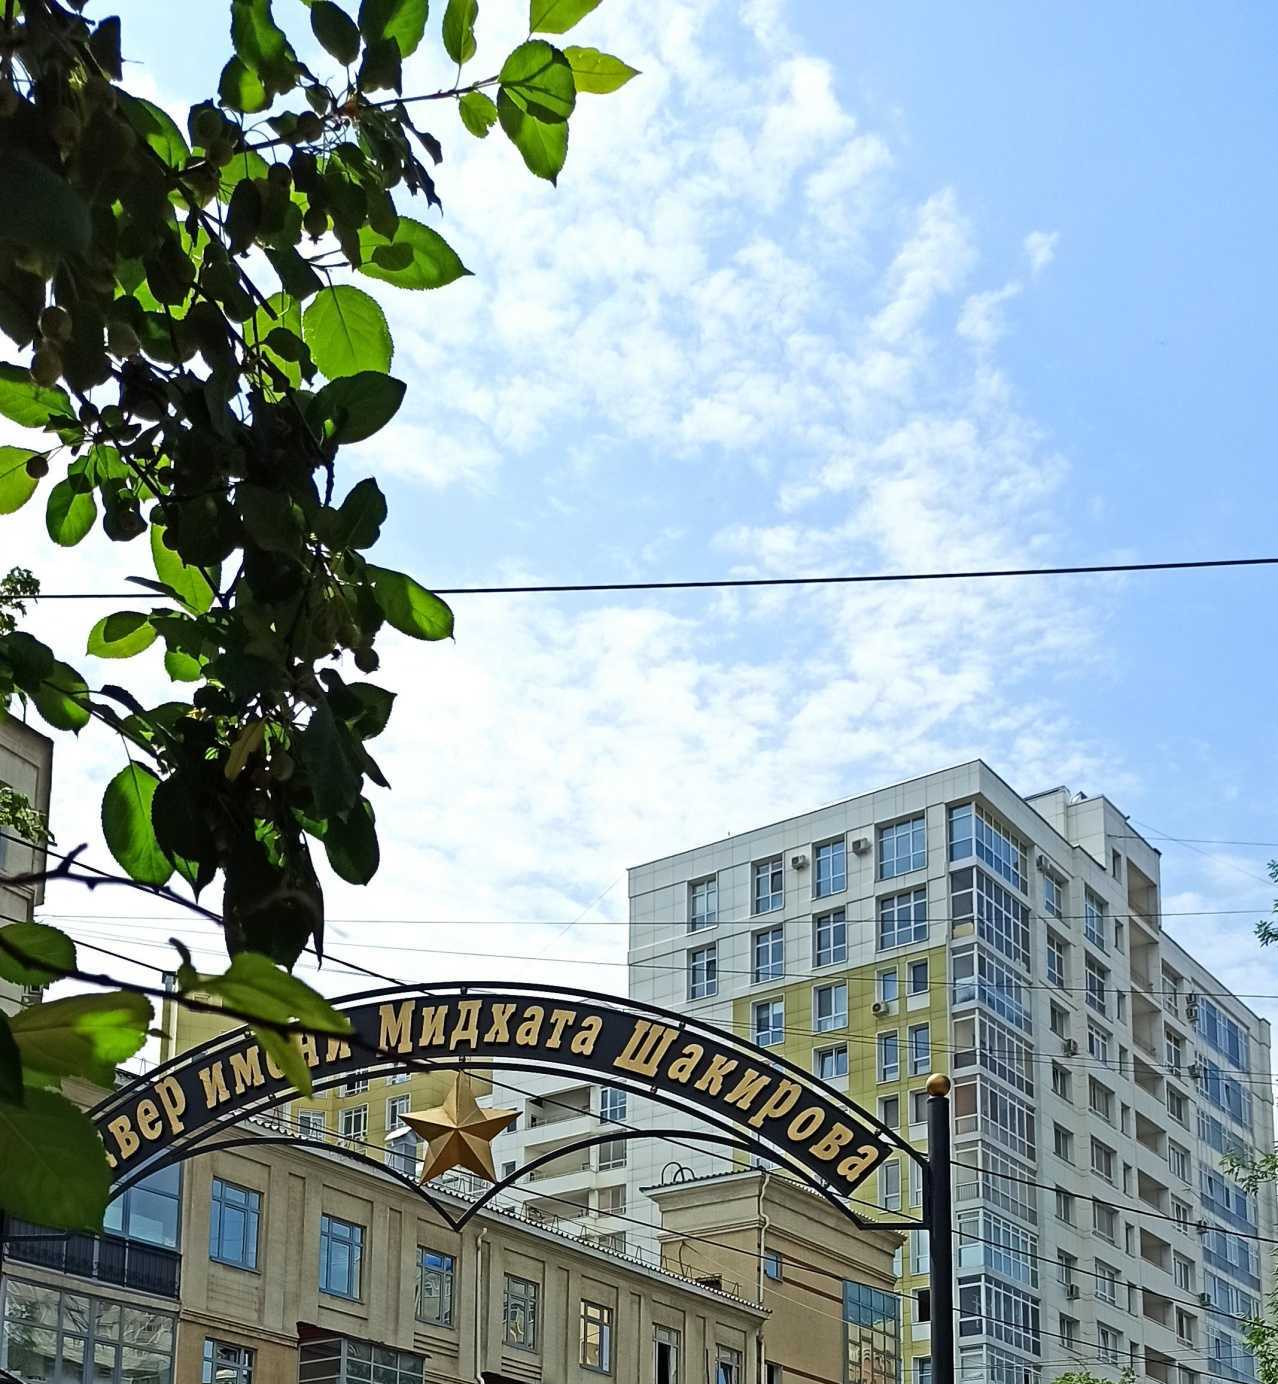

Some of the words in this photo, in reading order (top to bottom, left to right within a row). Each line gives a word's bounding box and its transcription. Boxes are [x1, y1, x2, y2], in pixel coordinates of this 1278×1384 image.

[97, 1076, 186, 1168] вер
[376, 1000, 603, 1056] Мидхата
[612, 1019, 879, 1182] Шакирова
